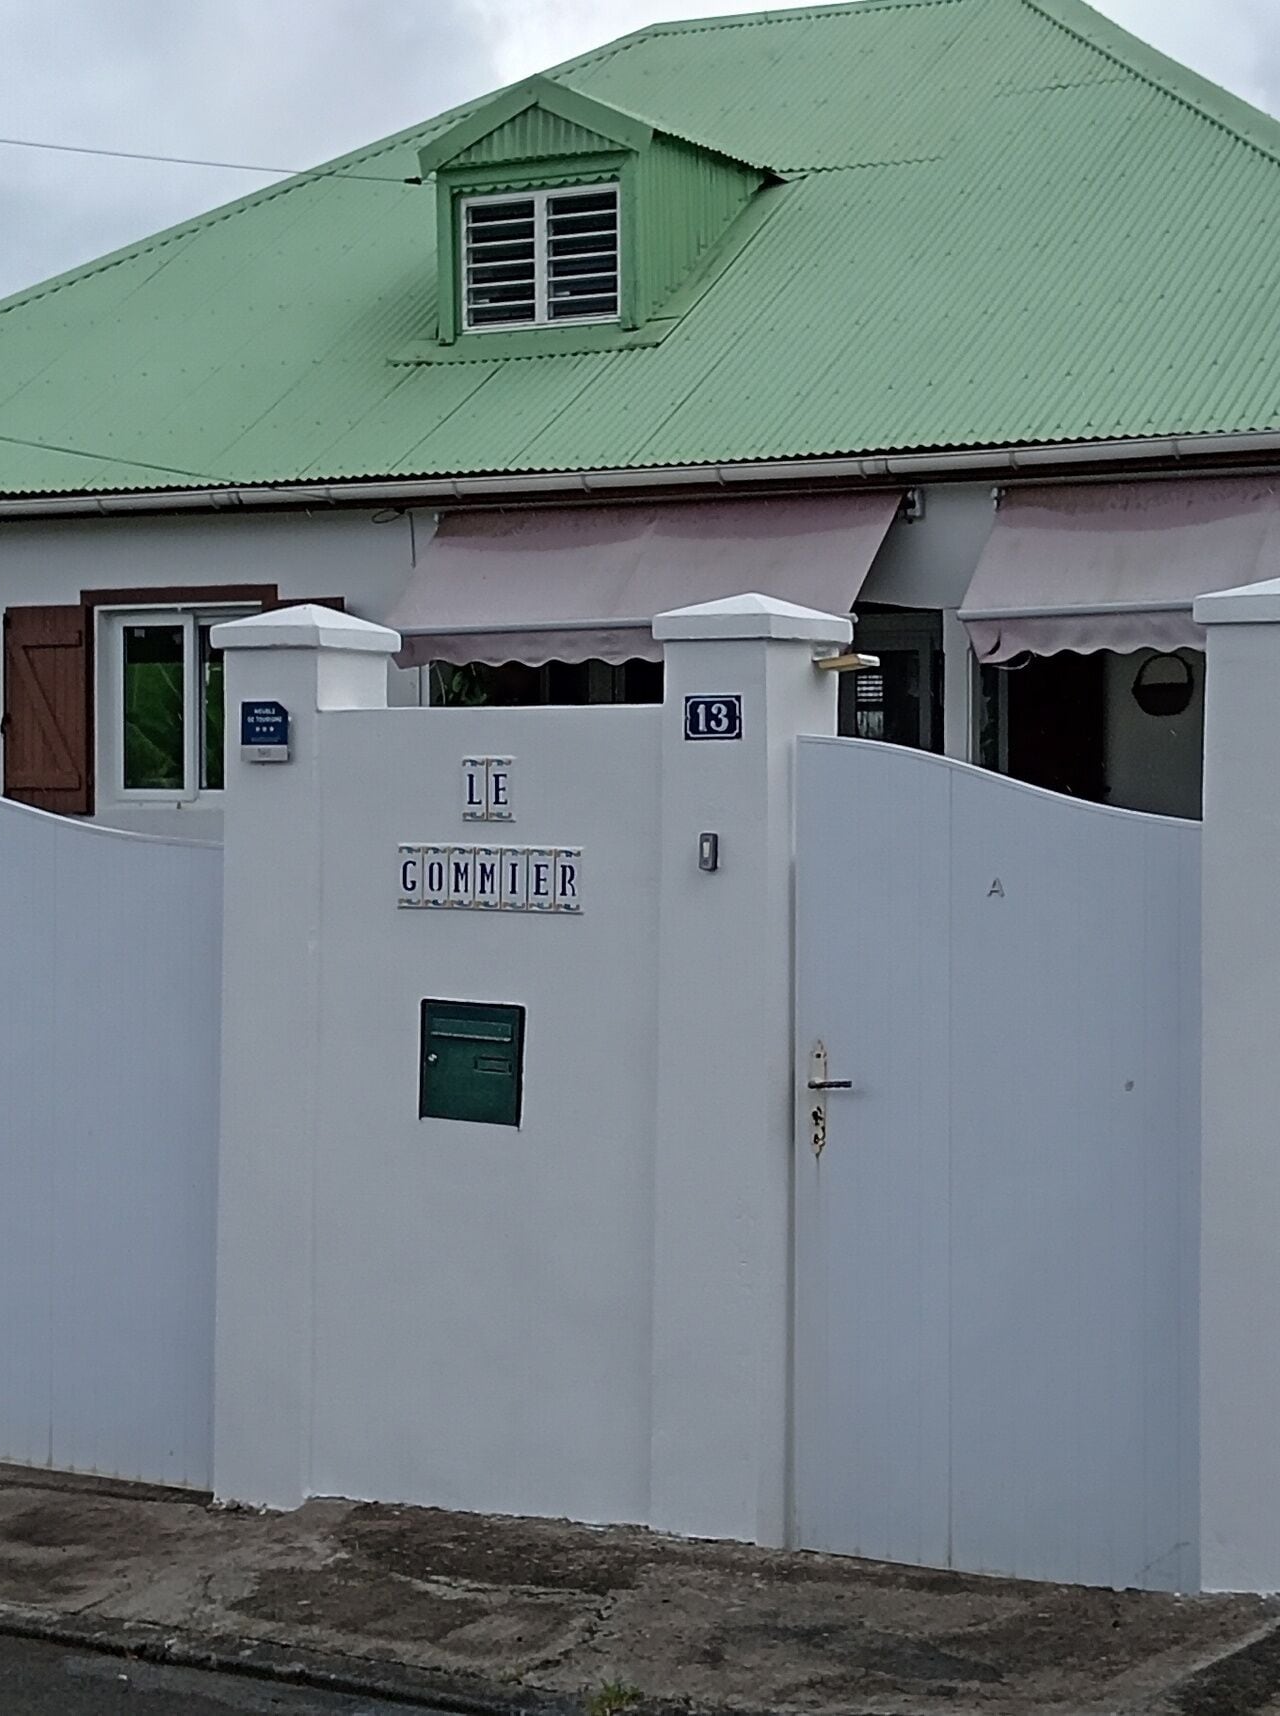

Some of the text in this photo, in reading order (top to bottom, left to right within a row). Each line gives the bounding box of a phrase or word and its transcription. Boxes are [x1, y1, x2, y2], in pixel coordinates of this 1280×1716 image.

[697, 703, 729, 731] 13
[466, 773, 508, 805] LE
[401, 859, 577, 897] GOMMIER
